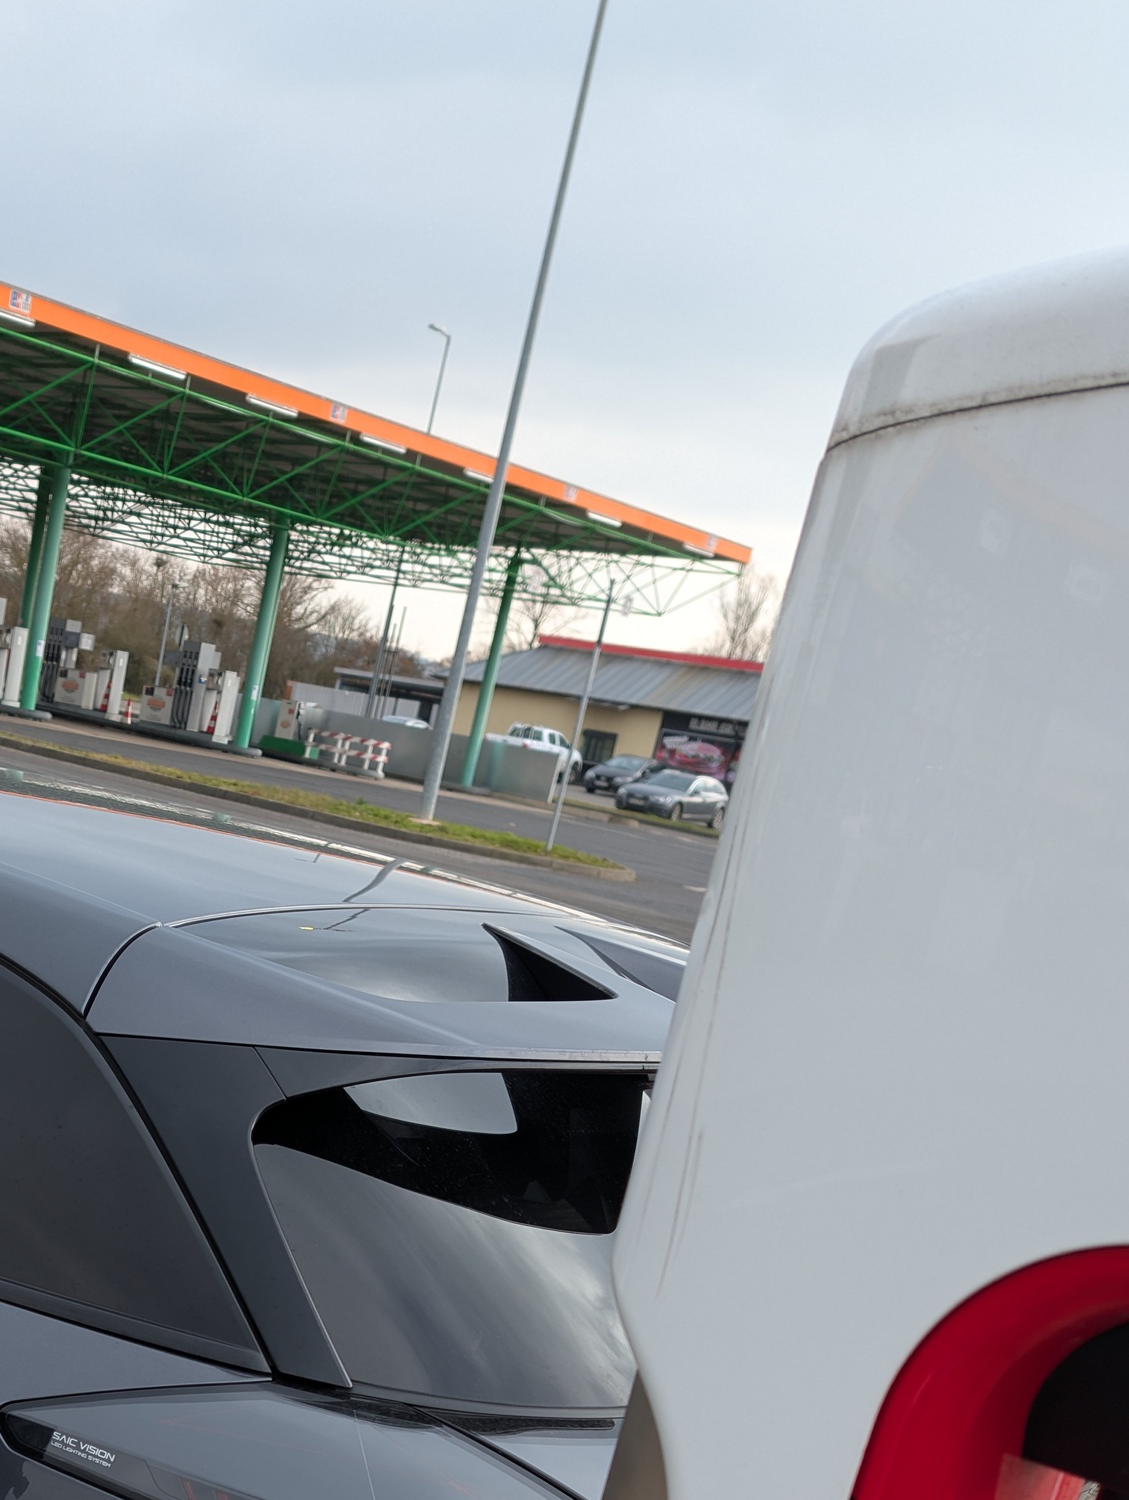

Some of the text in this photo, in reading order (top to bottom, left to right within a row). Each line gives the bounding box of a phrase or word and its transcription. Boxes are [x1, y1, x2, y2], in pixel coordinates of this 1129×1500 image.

[50, 1440, 111, 1467] LED LIGHTING SYSTEM
[52, 1431, 116, 1462] SAIC VISION
